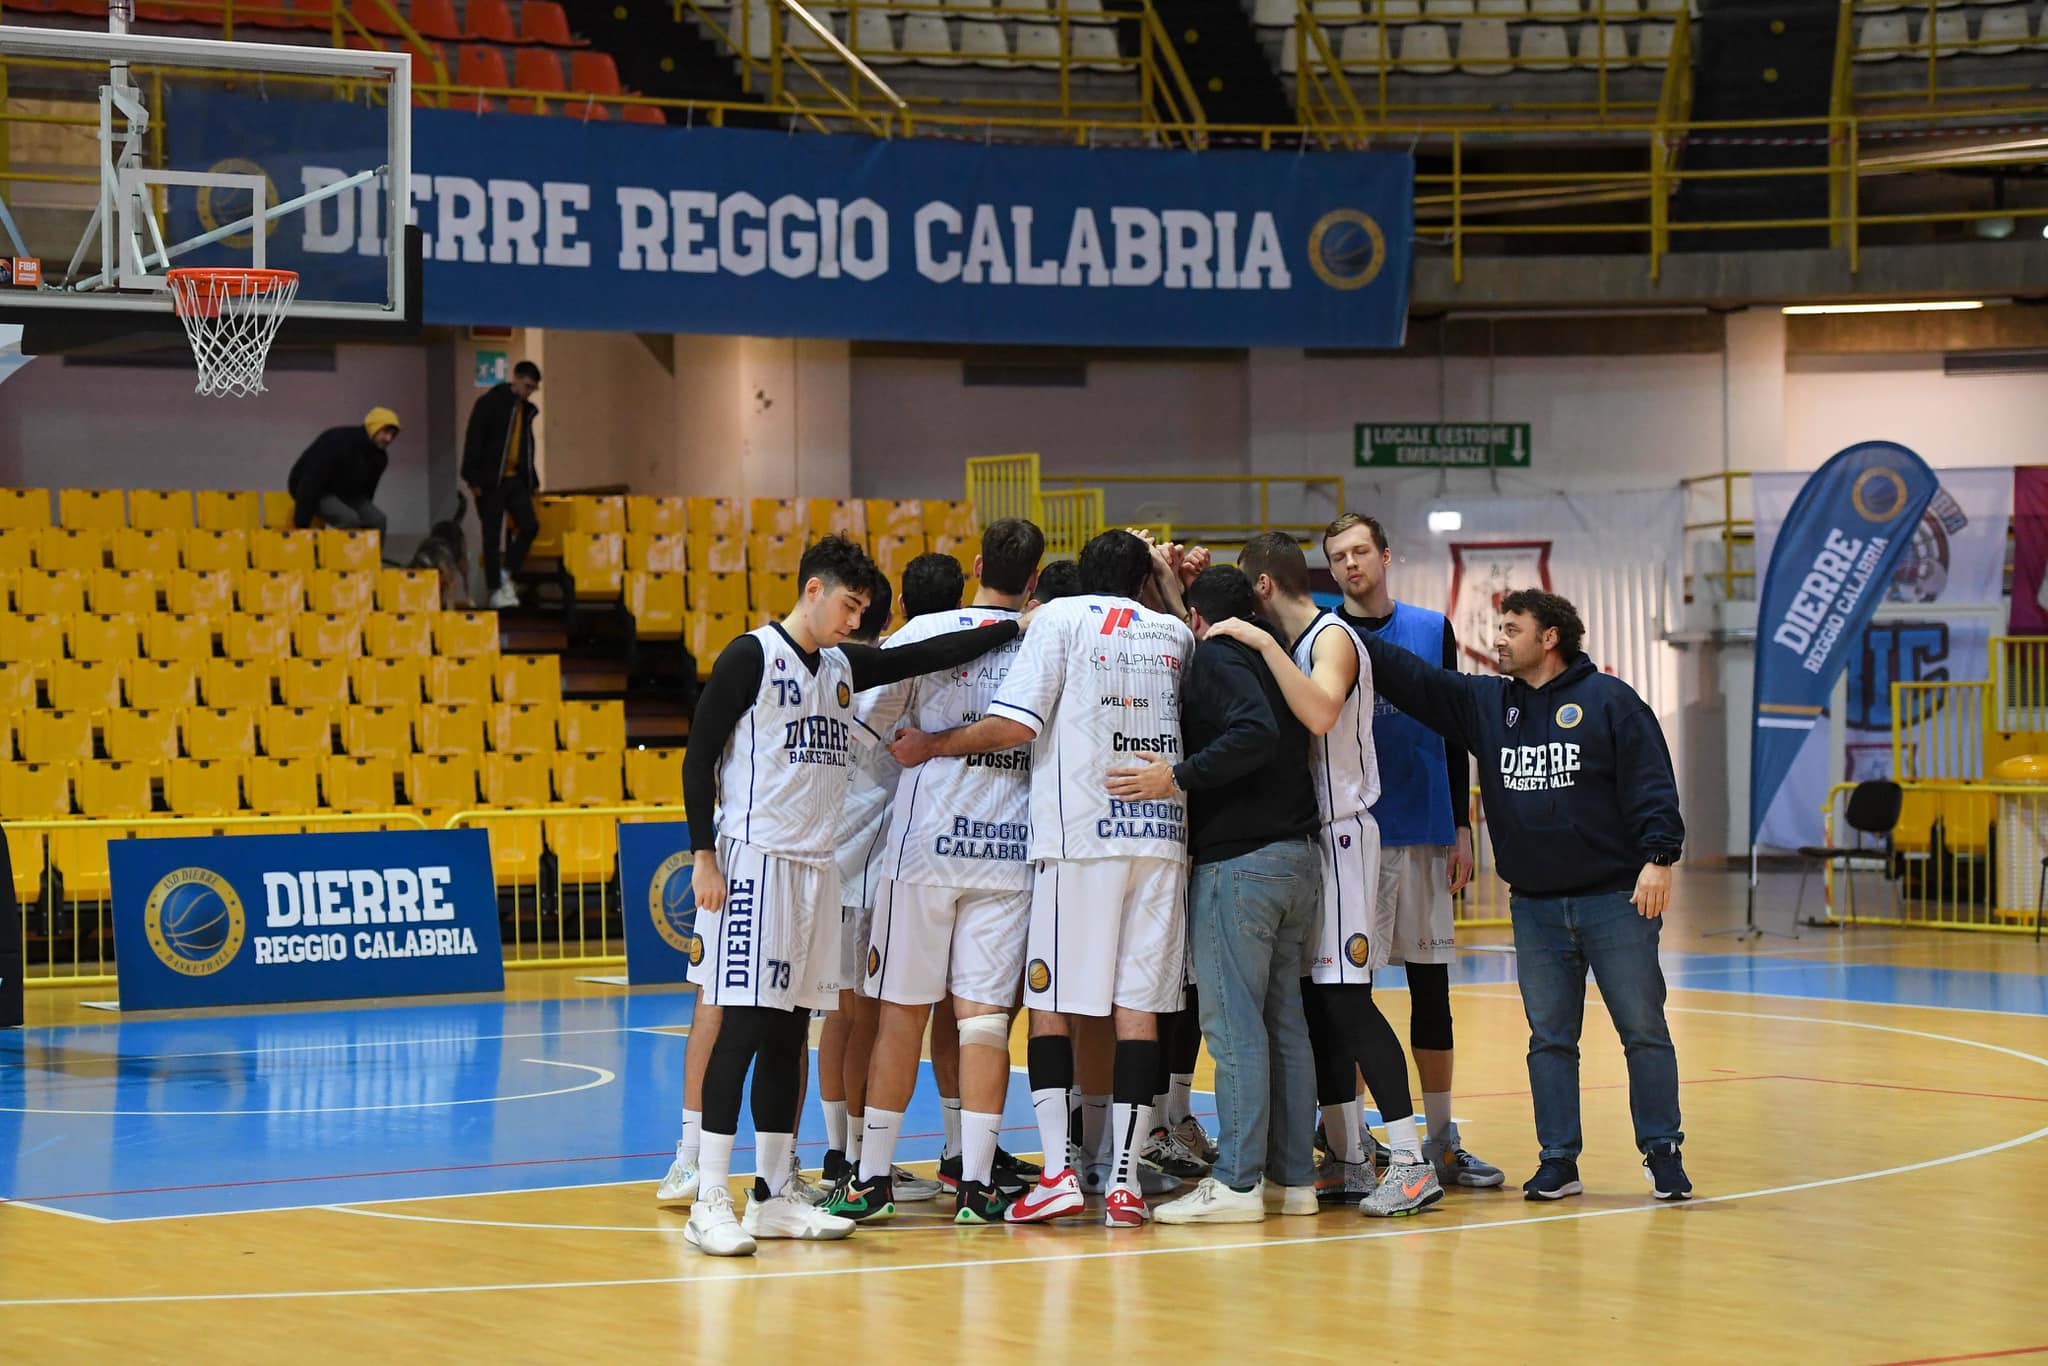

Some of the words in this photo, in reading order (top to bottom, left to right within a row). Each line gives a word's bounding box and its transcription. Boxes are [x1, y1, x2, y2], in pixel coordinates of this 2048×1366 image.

[617, 187, 889, 281] REGGIO
[914, 201, 1292, 290] CALABRIA
[18, 261, 37, 271] FIBA
[1374, 427, 1430, 445] LOCALE
[1773, 528, 1863, 655] DIERRE
[1803, 613, 1846, 674] REGGIO
[1836, 536, 1889, 614] CALABRIA
[771, 679, 802, 707] 73
[1101, 695, 1149, 708] WELLNESS
[784, 715, 849, 752] DIERRE
[1112, 732, 1178, 754] CrossFit
[789, 750, 847, 767] BASKETBALL
[1500, 742, 1581, 777] DIERRE
[1098, 819, 1186, 842] CALABRI
[936, 836, 1028, 860] CALABRI
[181, 869, 218, 885] DIERRE
[262, 866, 455, 928] DIERRE
[253, 932, 348, 964] REGGIO
[354, 927, 478, 959] CALABRIA
[725, 879, 755, 988] DIERRE
[767, 960, 791, 990] 73
[1113, 1192, 1128, 1203] 34
